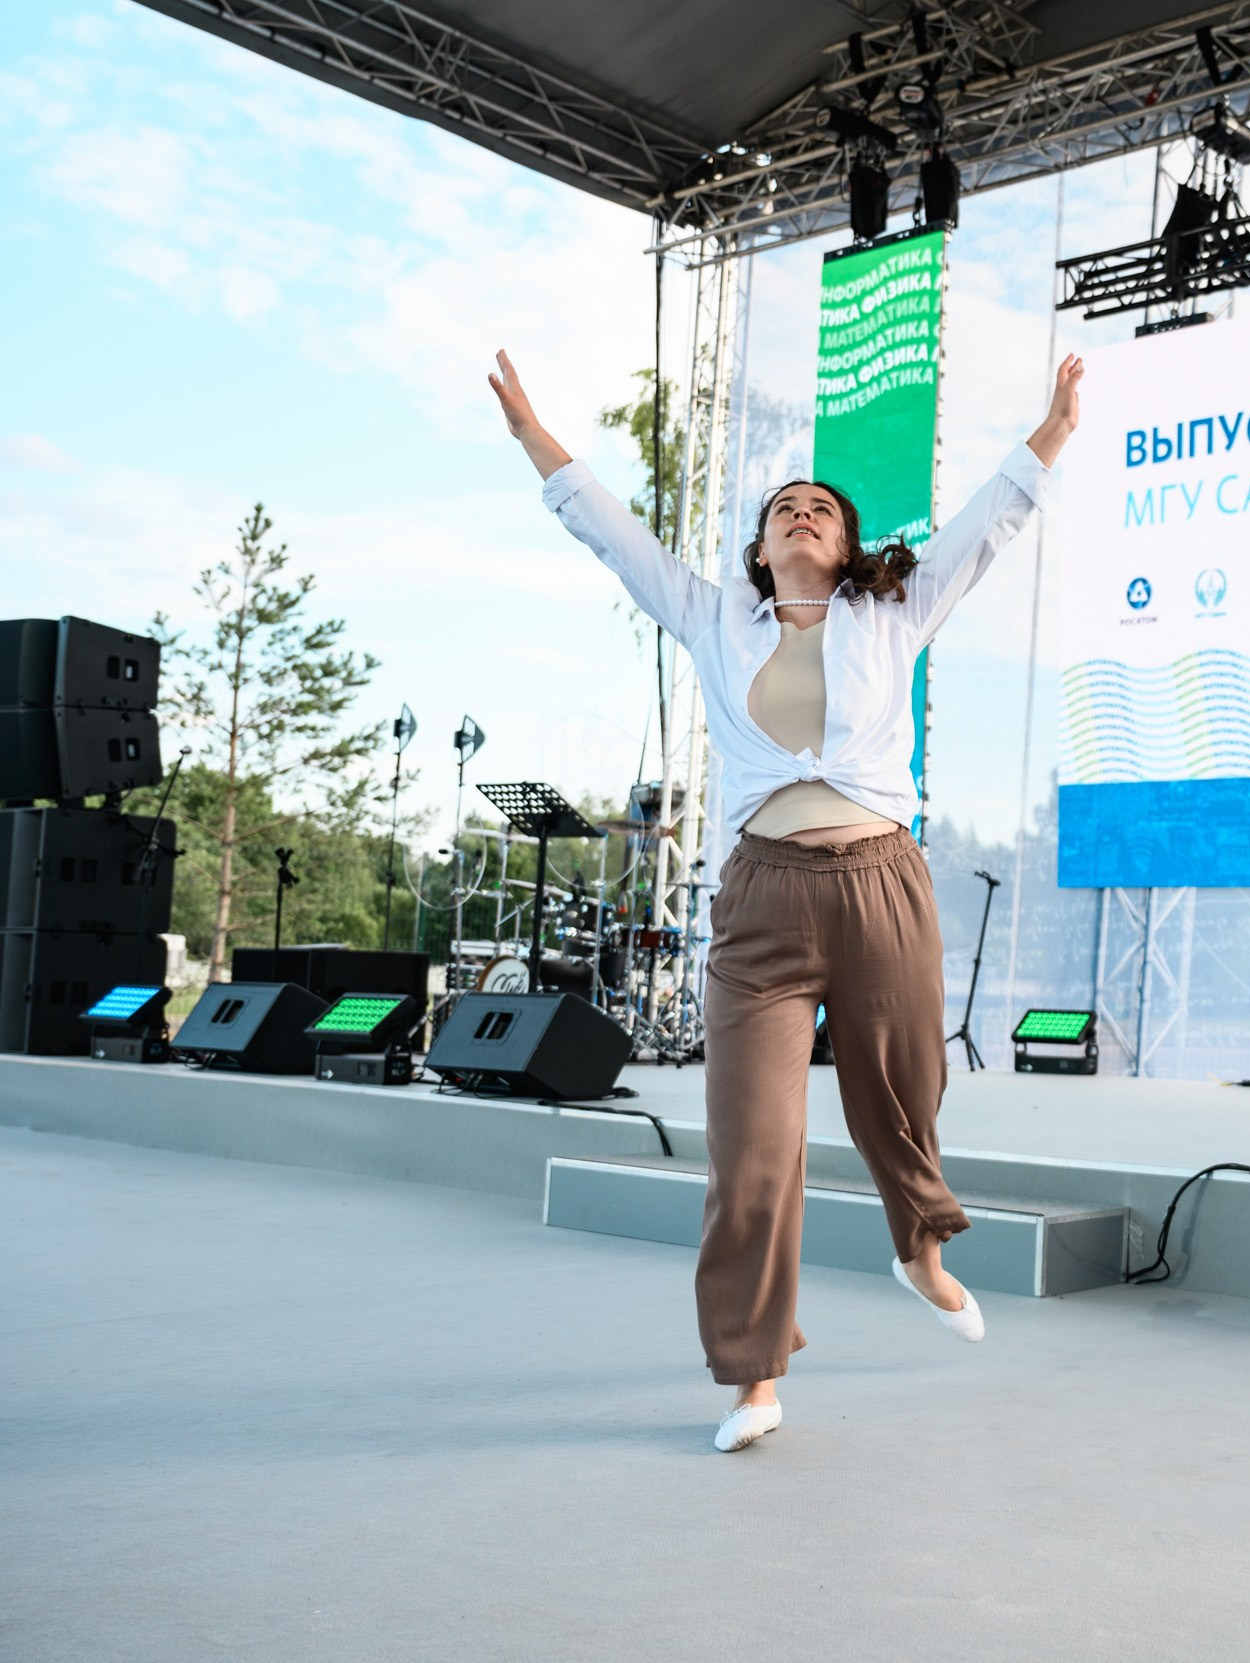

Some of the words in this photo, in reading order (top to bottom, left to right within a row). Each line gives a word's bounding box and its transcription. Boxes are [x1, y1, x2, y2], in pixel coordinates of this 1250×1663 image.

[861, 271, 932, 314] ФИЗИКА
[824, 294, 930, 350] МАТЕМАТИКА
[858, 342, 928, 384] ФИЗИКА
[826, 366, 934, 417] МАТЕМАТИКА
[1124, 480, 1203, 529] МГУ
